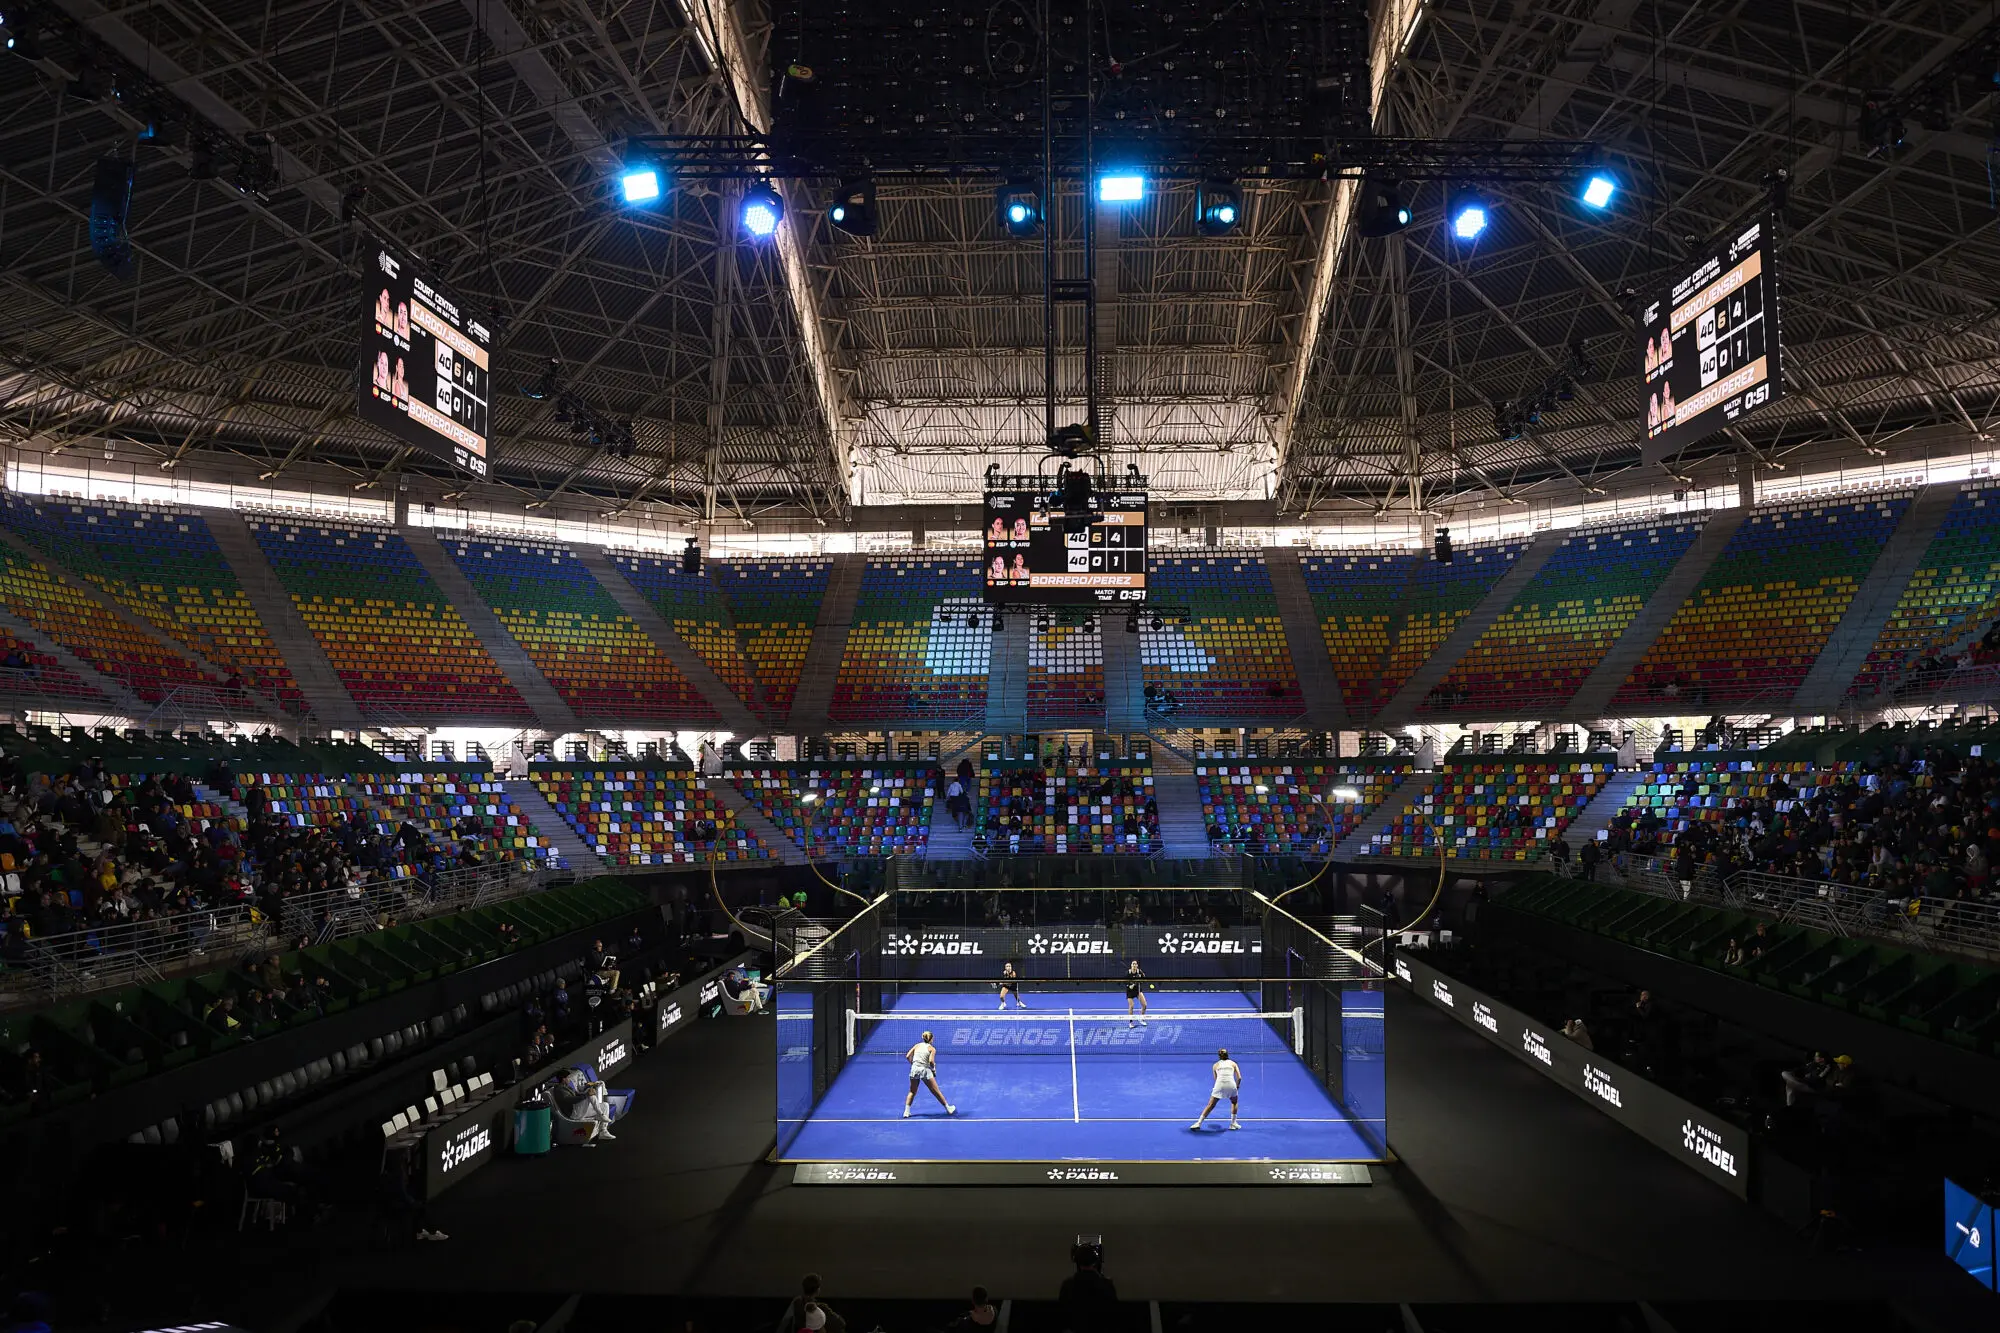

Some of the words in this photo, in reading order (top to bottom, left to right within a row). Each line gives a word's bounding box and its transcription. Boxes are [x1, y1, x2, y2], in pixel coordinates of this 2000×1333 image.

[1672, 276, 1691, 298] COURT
[1692, 256, 1719, 283] CENTRAL
[414, 277, 434, 298] COURT
[434, 293, 459, 318] CENTRAL
[1671, 268, 1743, 329] ICARDO/JENSEN
[1718, 310, 1726, 329] 6
[1733, 301, 1741, 318] 4
[411, 304, 476, 359] ICARDO/JENSEN
[1701, 321, 1713, 338] 40
[1720, 349, 1728, 367] 0
[1737, 340, 1742, 357] 1
[439, 353, 451, 370] 40
[454, 362, 461, 378] 6
[466, 371, 473, 386] 4
[1702, 357, 1715, 374] 40
[1676, 367, 1754, 418] BORRERO/PEREZ
[1745, 383, 1769, 410] 0:51
[438, 388, 450, 405] 40
[453, 397, 460, 412] 0
[468, 405, 472, 419] 1
[1723, 397, 1741, 412] MATCH
[1727, 407, 1739, 420] TIME
[409, 401, 478, 450] BORRERO/PEREZ
[454, 446, 468, 459] MATCH
[456, 456, 466, 467] TIME
[470, 456, 487, 476] 0:51
[1069, 533, 1087, 543] 40
[1092, 532, 1102, 542] 6
[1110, 532, 1121, 542] 4
[1069, 556, 1087, 566] 40
[1092, 556, 1102, 566] 0
[1113, 556, 1119, 566] 1
[1031, 576, 1132, 586] BORRERO/PEREZ
[1119, 590, 1146, 600] 0:51
[920, 942, 983, 955] PADEL
[1050, 941, 1113, 954] PADEL
[1181, 940, 1244, 954] PADEL
[1438, 988, 1454, 1007] PADEL
[1479, 1011, 1498, 1033] PADEL
[952, 1028, 1061, 1046] BUENOS
[1065, 1026, 1147, 1046] AIRES
[605, 1044, 626, 1069] PADEL
[1530, 1040, 1552, 1067] PADEL
[1593, 1067, 1611, 1082] PREMIER
[1592, 1077, 1622, 1108] PADEL
[1697, 1124, 1722, 1144] PREMIER
[454, 1129, 490, 1166] PADEL
[1695, 1136, 1737, 1177] PADEL
[844, 1172, 897, 1180] PADEL
[1066, 1172, 1119, 1180] PADEL
[1289, 1172, 1342, 1180] PADEL
